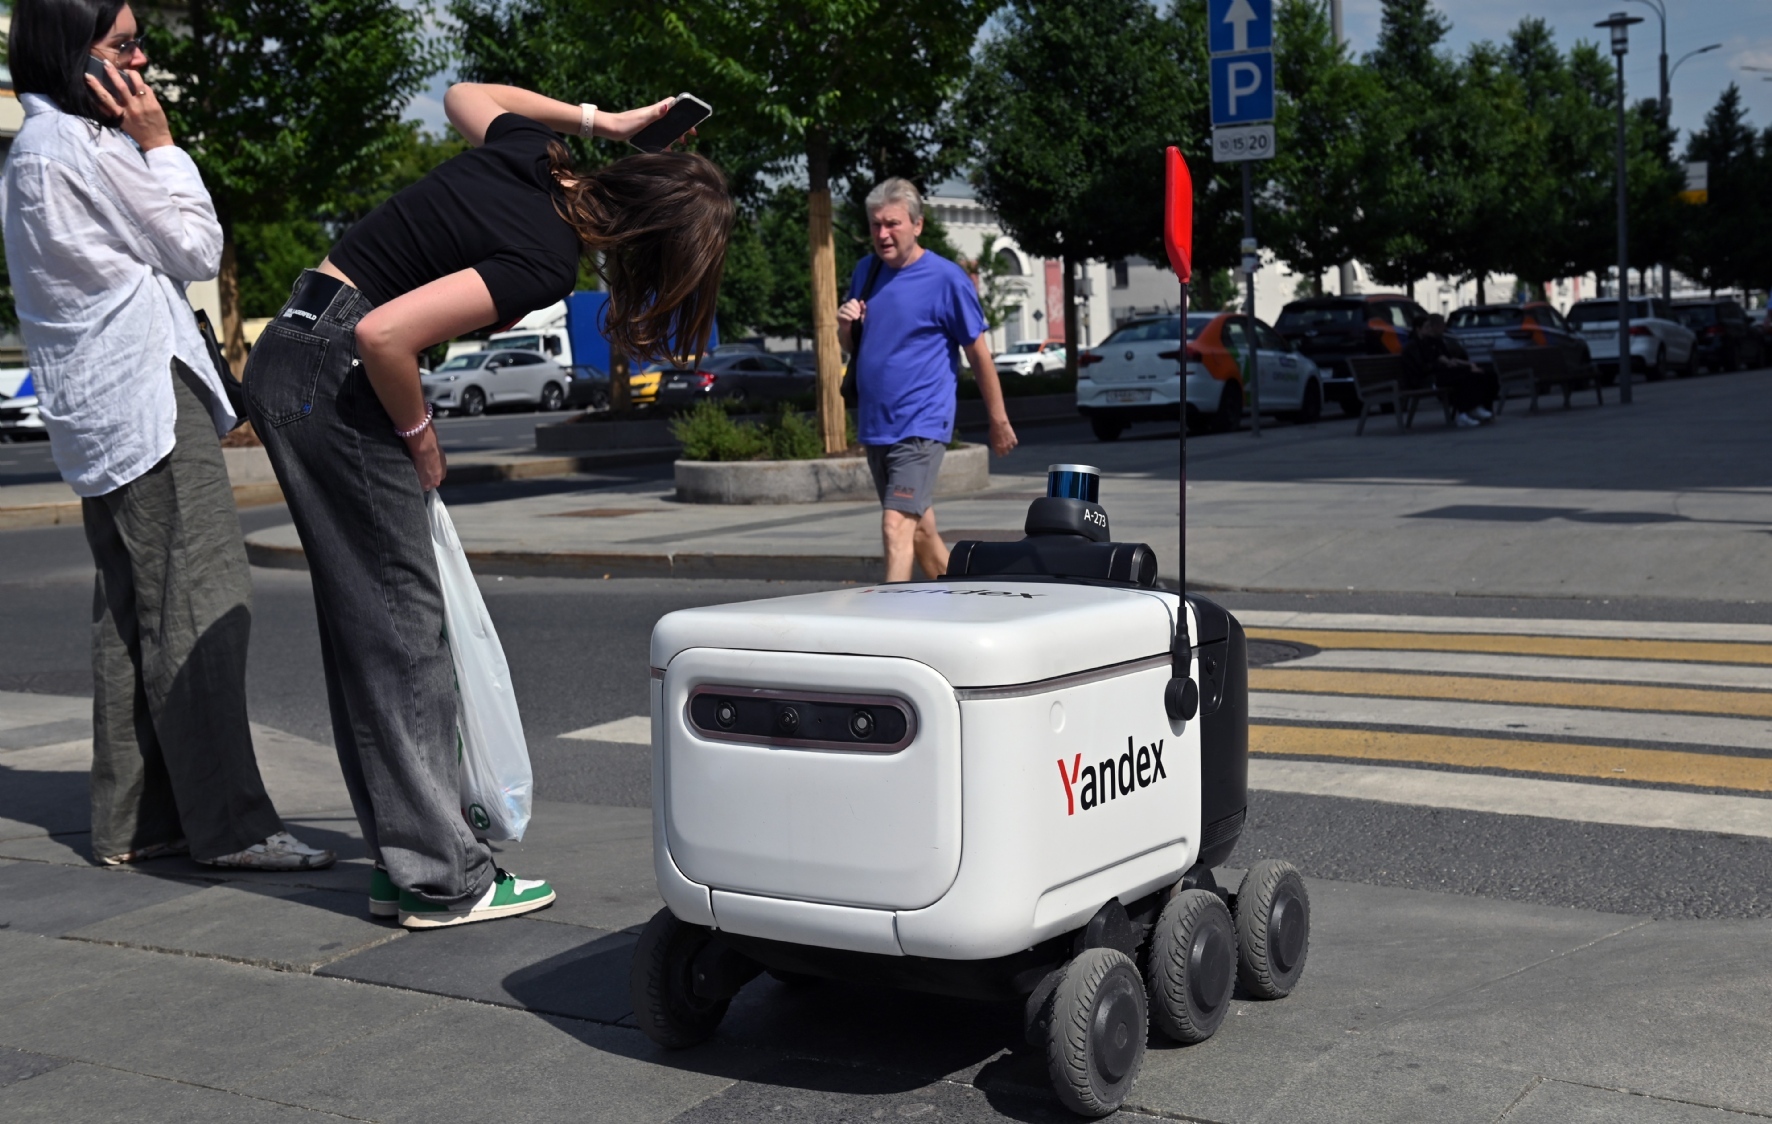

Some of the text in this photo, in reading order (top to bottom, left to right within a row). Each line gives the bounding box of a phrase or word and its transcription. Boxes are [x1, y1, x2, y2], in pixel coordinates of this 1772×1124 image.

[1227, 61, 1262, 116] P
[1233, 137, 1244, 150] 15
[1249, 134, 1267, 150] 20
[1083, 508, 1106, 528] A-273
[1057, 735, 1167, 816] Yandex
